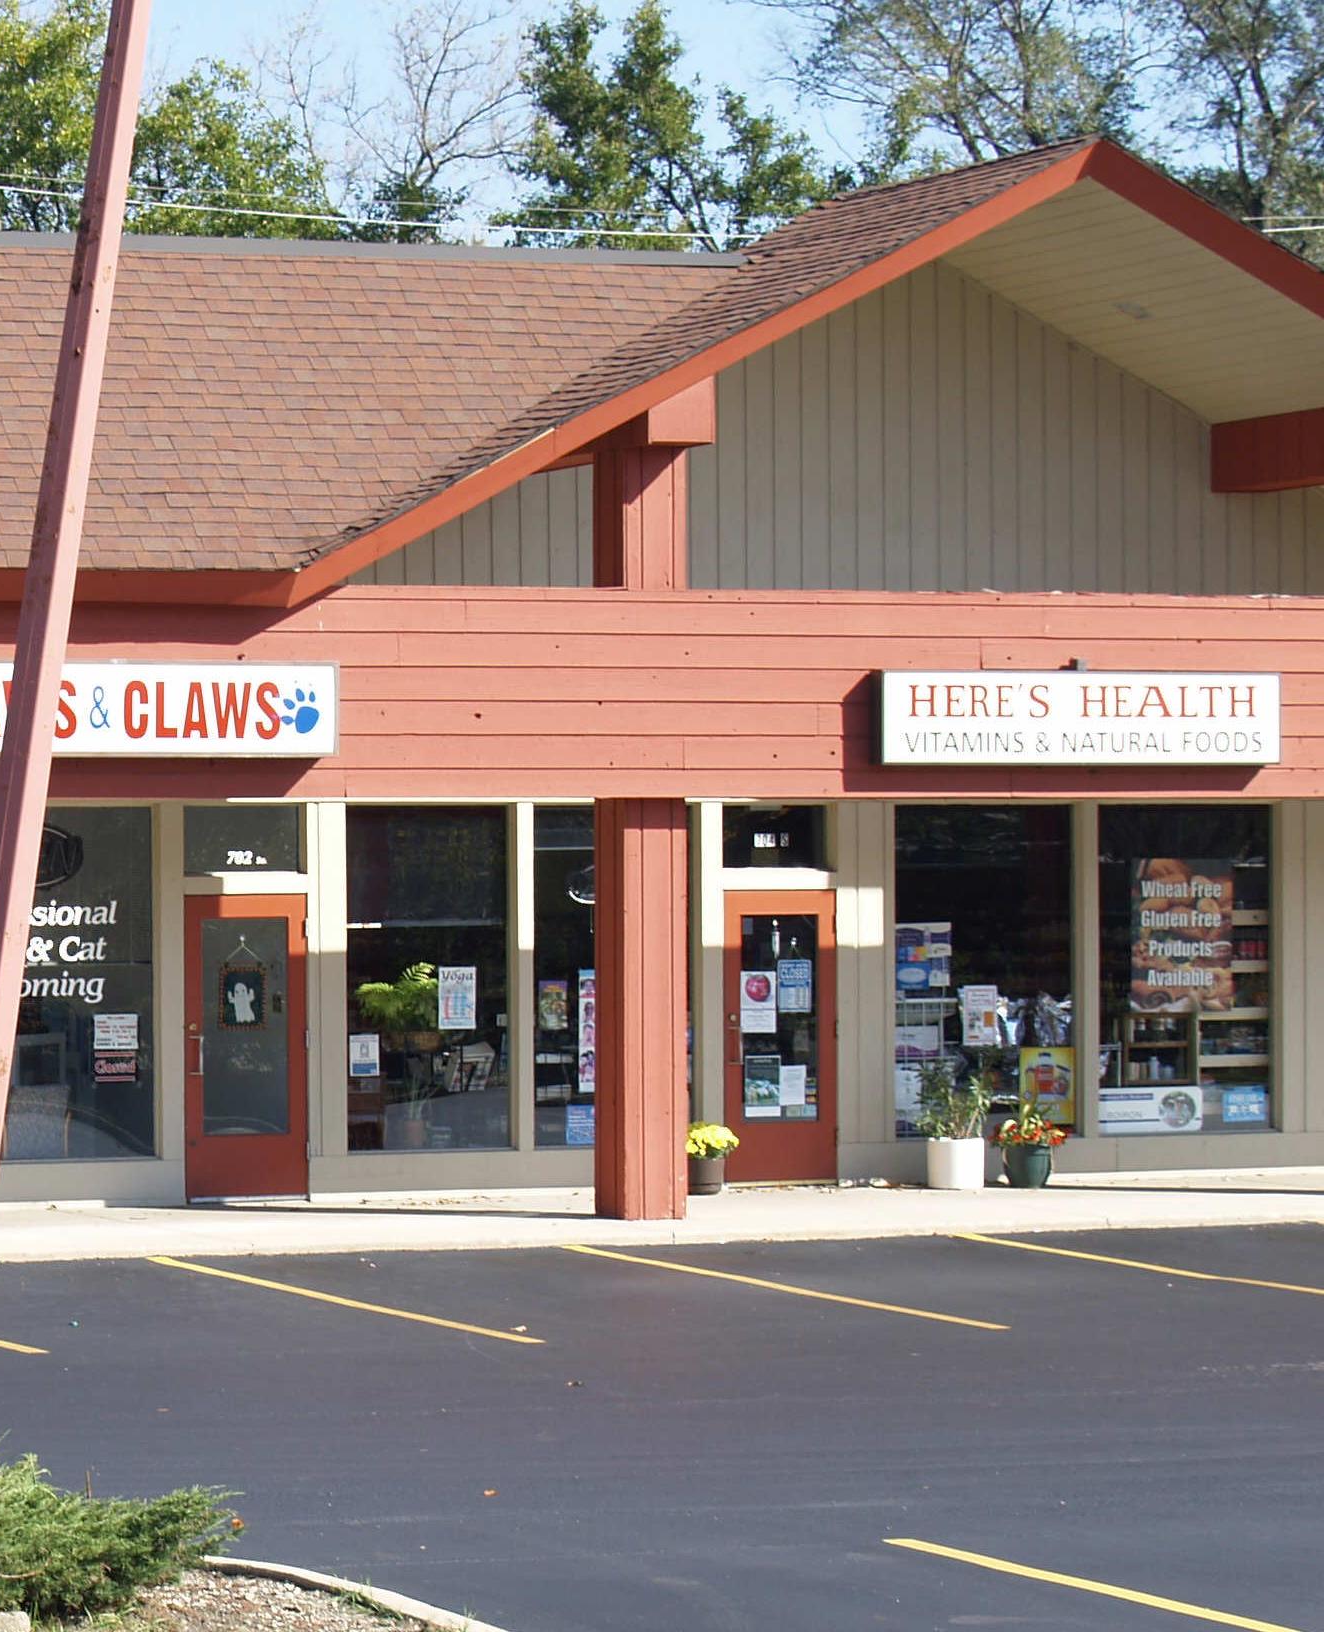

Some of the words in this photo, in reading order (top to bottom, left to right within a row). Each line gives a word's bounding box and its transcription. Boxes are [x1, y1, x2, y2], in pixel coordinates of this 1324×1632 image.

[89, 686, 111, 729] &
[123, 679, 281, 740] CLAWS
[907, 683, 1052, 718] HERE'S
[1079, 684, 1257, 719] HEALTH
[904, 731, 1025, 753] VITAMINS
[1035, 731, 1051, 753] &
[1061, 731, 1173, 753] NATURAL
[1182, 731, 1263, 753] FOODS
[1141, 881, 1188, 898] Wheat
[1190, 881, 1222, 898] Free
[1140, 910, 1188, 927] Gluten
[1191, 910, 1221, 927] Free
[26, 936, 54, 963] &
[58, 935, 108, 962] Cat
[1148, 940, 1213, 957] Products
[441, 969, 474, 984] Yoga
[1147, 969, 1214, 987] Available
